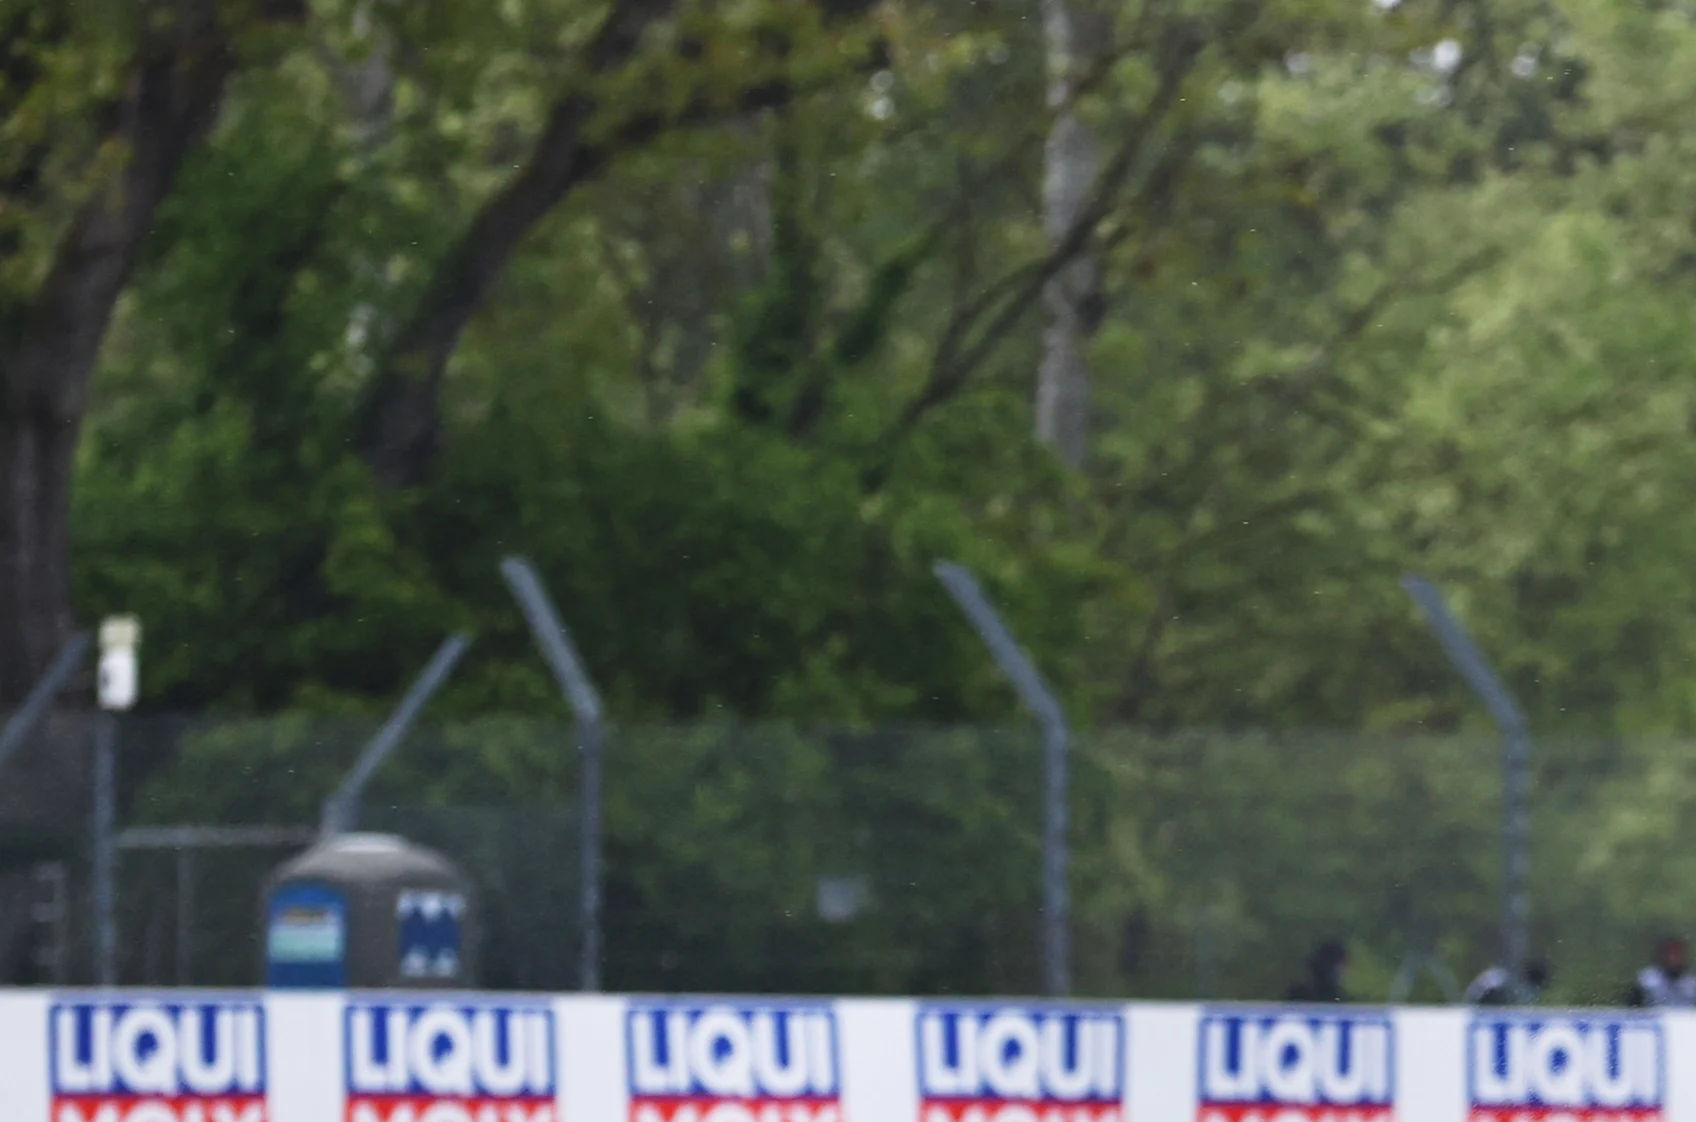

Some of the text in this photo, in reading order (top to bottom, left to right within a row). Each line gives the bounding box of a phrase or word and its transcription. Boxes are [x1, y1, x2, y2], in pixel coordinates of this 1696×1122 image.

[56, 1008, 260, 1091] LIQUI
[350, 1010, 554, 1093] LIQUI
[634, 1010, 837, 1094] LIQUI
[924, 1013, 1120, 1096] LIQUI
[1205, 1016, 1391, 1101] LIQUI
[1474, 1020, 1661, 1104] LIQUI
